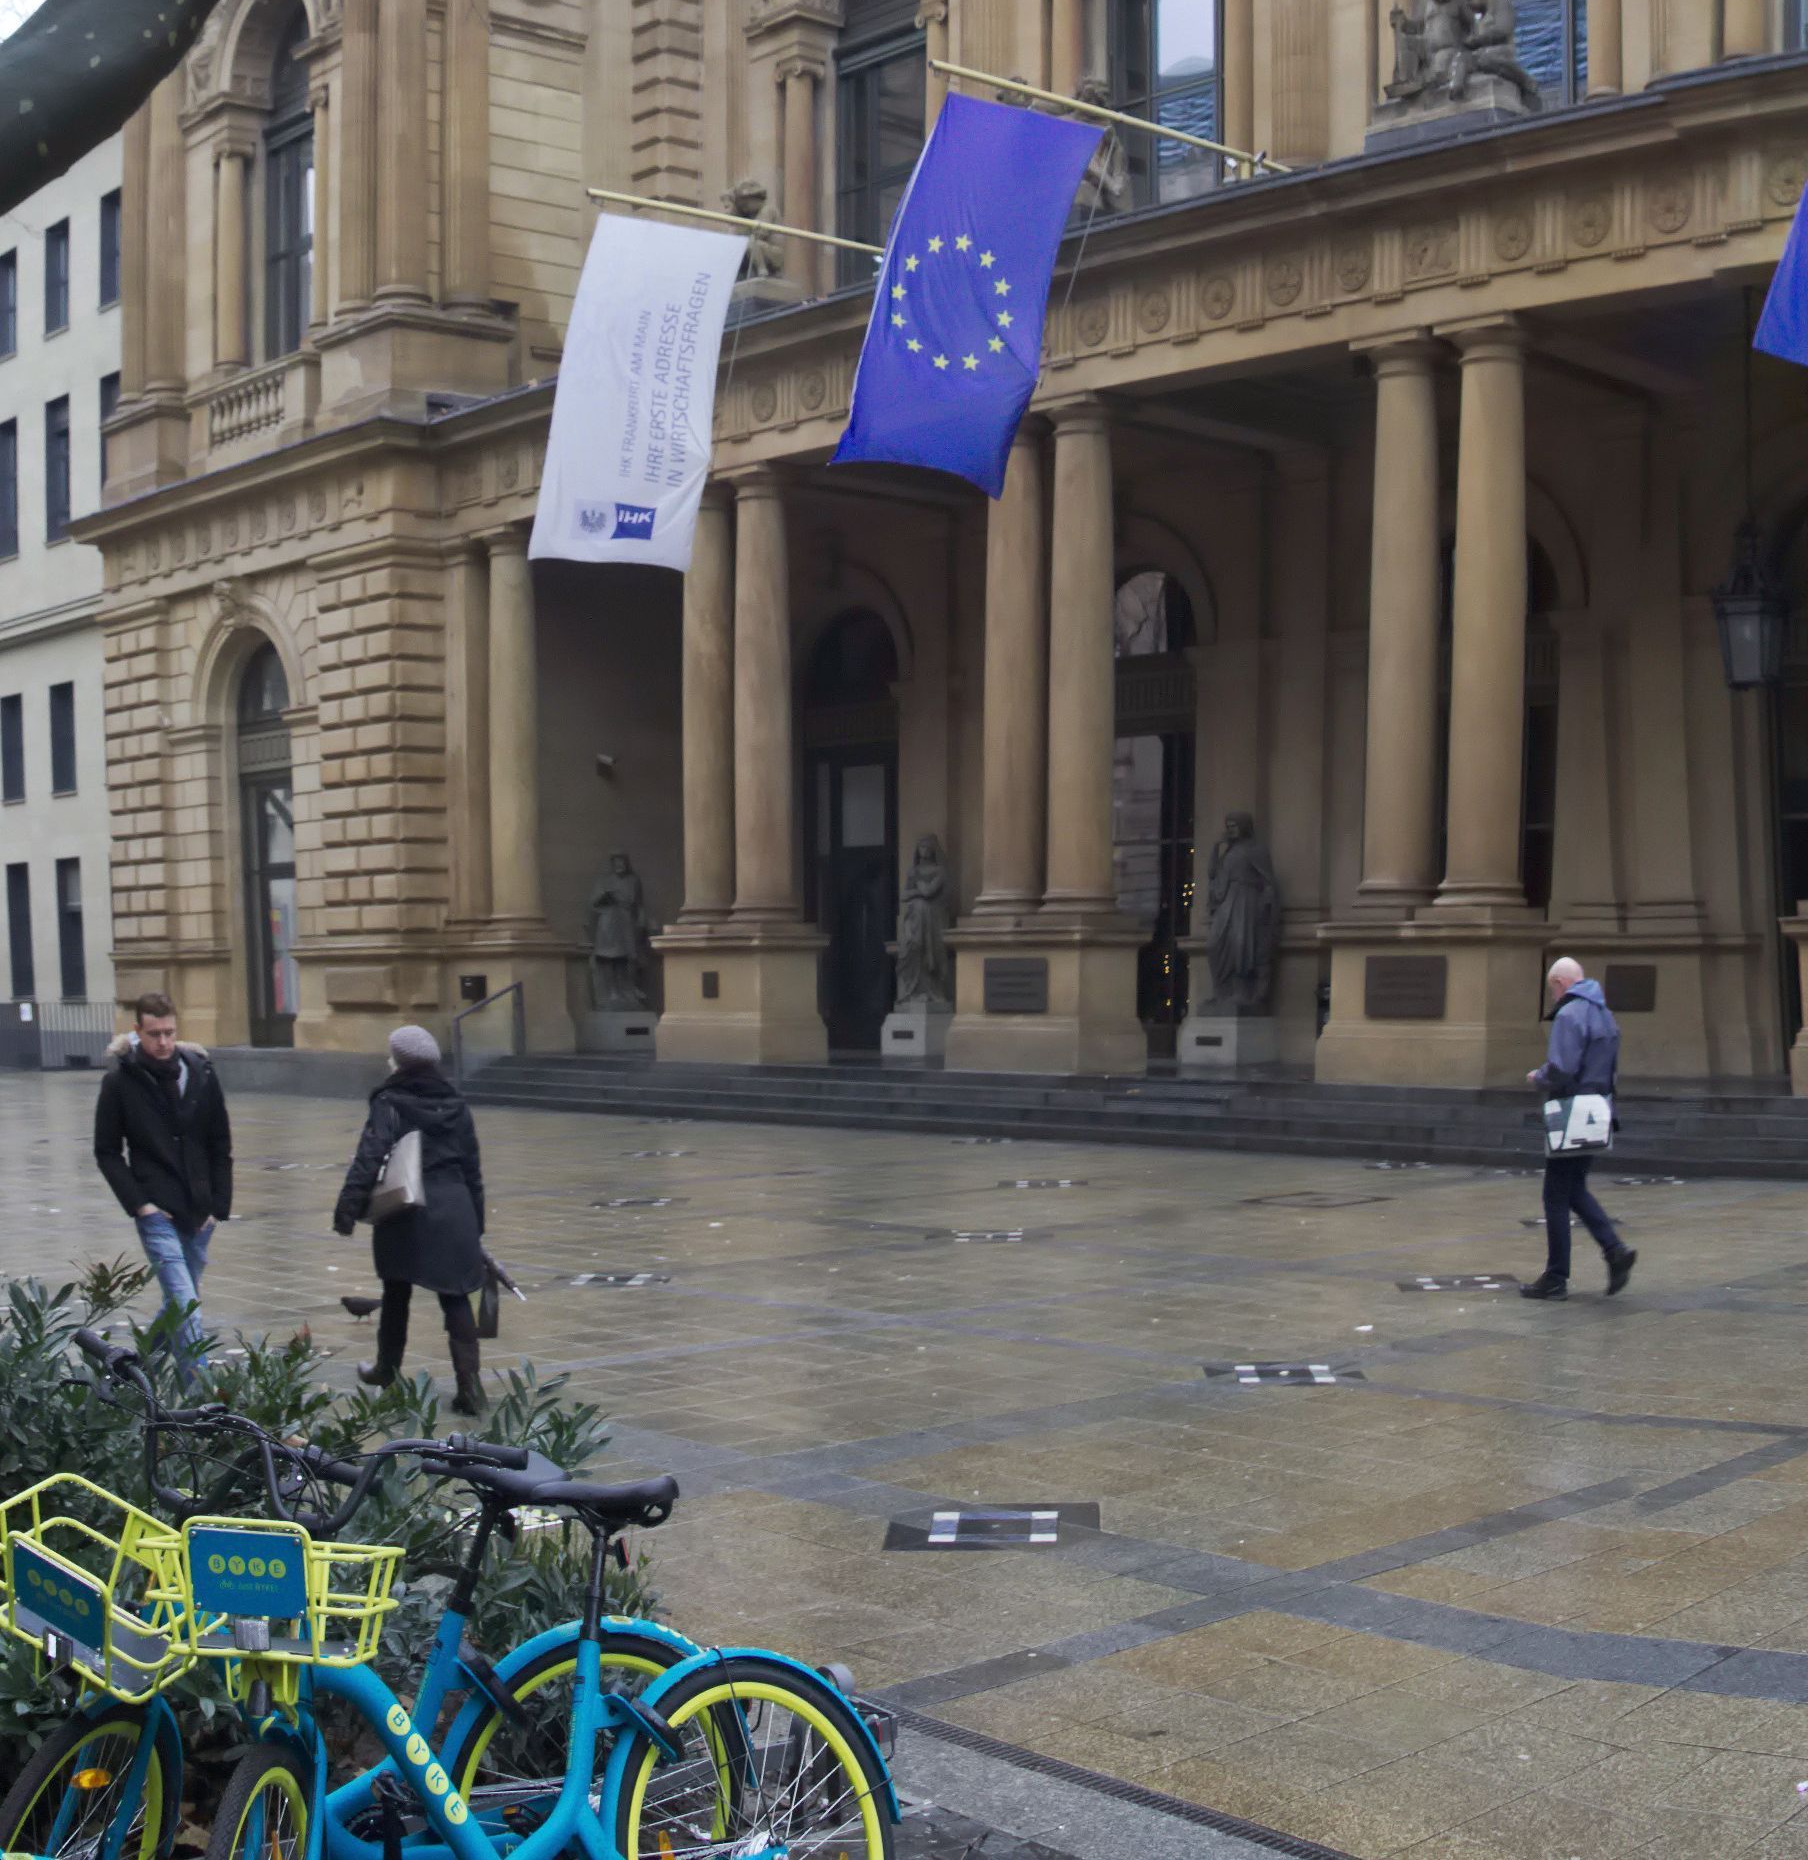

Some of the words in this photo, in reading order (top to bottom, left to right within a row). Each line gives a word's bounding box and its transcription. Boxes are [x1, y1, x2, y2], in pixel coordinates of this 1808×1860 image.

[633, 310, 651, 348] MAIN
[655, 302, 682, 386] ADRESSE
[630, 352, 643, 377] AM
[671, 272, 712, 464] WIRTSCHAFTSFRAGEN
[621, 381, 641, 453] FRANKFURT
[649, 389, 668, 441] ERSTE
[619, 455, 633, 478] IHK
[644, 443, 665, 484] IHRE
[667, 470, 685, 488] IN
[617, 509, 653, 524] IHK
[211, 1556, 283, 1576] BYKE
[390, 1707, 466, 1821] BYKE
